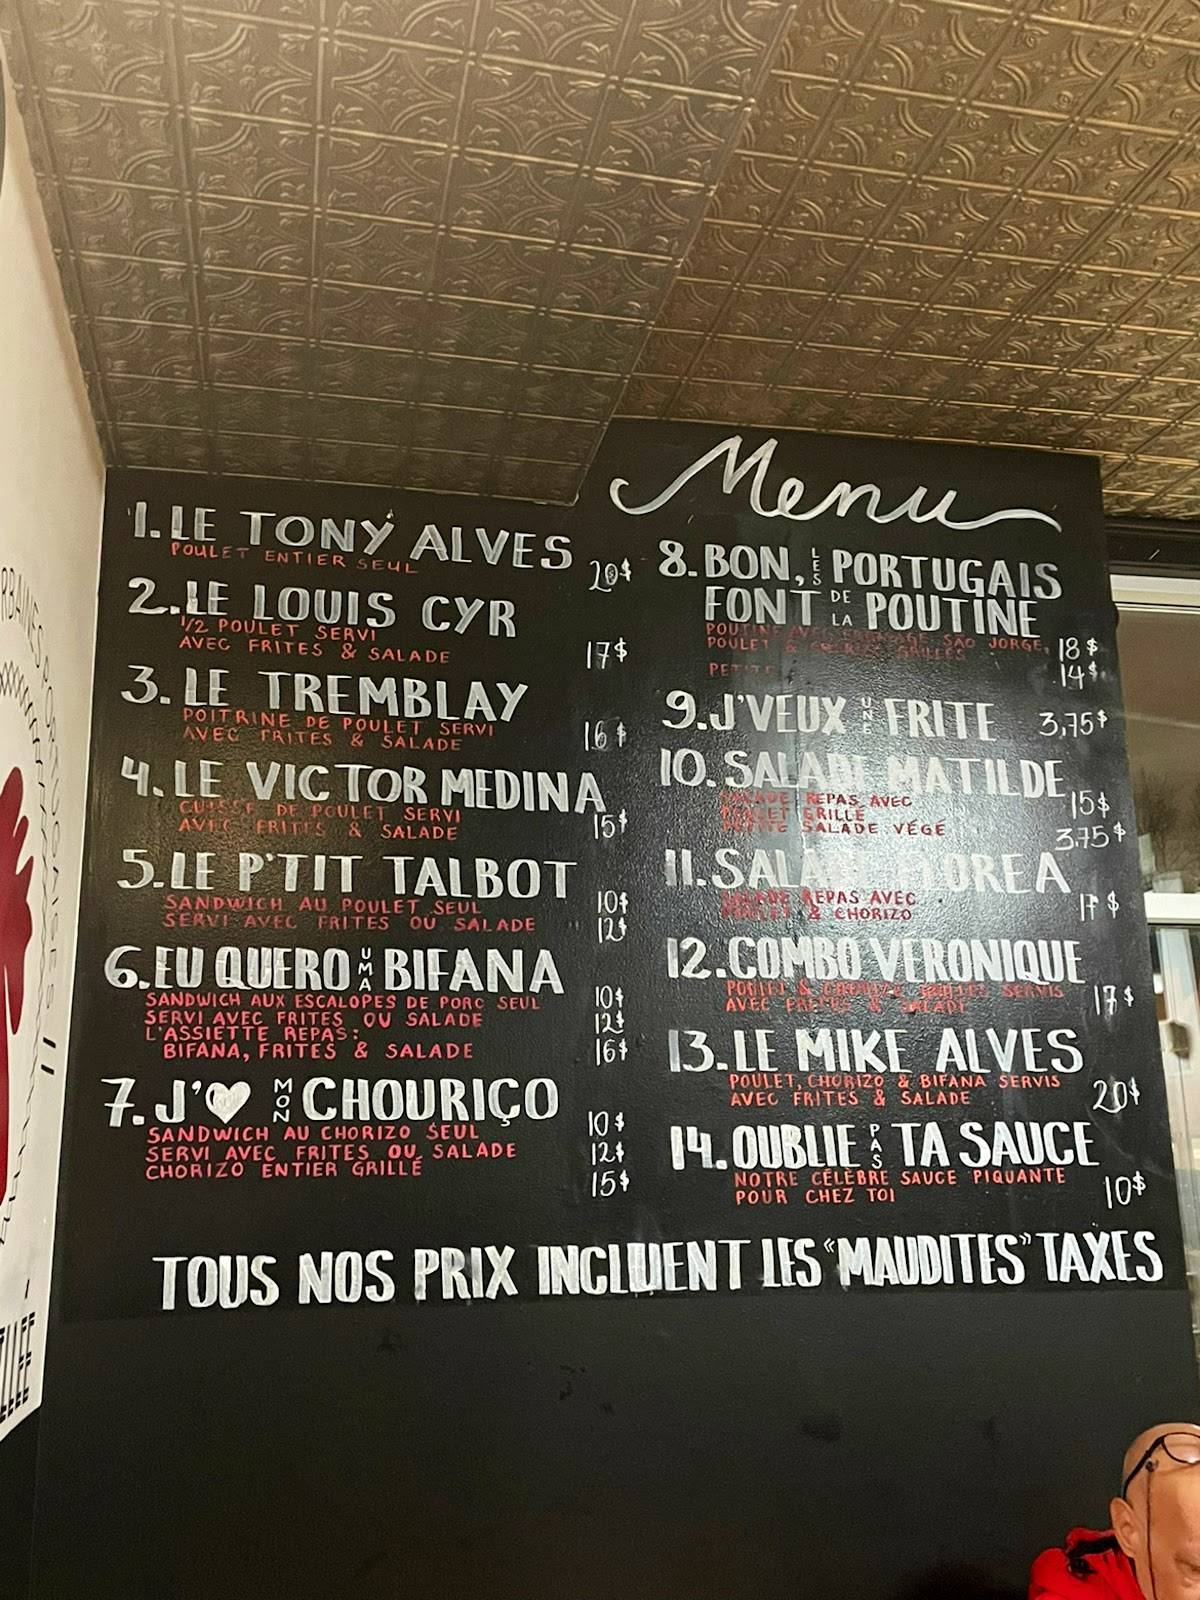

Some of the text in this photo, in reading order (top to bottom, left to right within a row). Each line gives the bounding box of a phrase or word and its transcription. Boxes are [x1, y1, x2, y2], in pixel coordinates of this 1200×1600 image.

[609, 435, 1062, 533] Menu
[240, 510, 395, 555] TONY
[409, 524, 574, 570] ALVES
[171, 541, 418, 574] POULET ENTIER SEUL
[833, 550, 1062, 600] PORTUGAIS
[704, 586, 822, 627] FONT
[831, 589, 850, 603] DE
[253, 584, 396, 628] LOUIS
[422, 594, 516, 638] CYR
[832, 612, 853, 627] LA
[866, 592, 1040, 638] POUTINE
[180, 615, 377, 641] 1/2 POULET SERVI
[179, 635, 450, 664] AVEC FRITES SALADE
[707, 637, 769, 650] POULET
[258, 671, 529, 723] TREMBLAY
[183, 707, 495, 737] POITRINE DE POULET SERVI
[885, 699, 998, 741] FRITE
[259, 728, 463, 752] FRITES SALADE
[245, 761, 428, 805] VICTOR
[440, 768, 608, 813] MEDINA
[889, 756, 1066, 798] MATILDE
[806, 793, 912, 807] REPAS AVEC
[276, 803, 462, 824] DE POULET SERVI
[803, 806, 865, 821] GRILLÉ
[381, 823, 458, 841] SALADE
[802, 818, 946, 836] SALADE VÉGÉ
[239, 852, 363, 893] P'TIT
[382, 855, 577, 899] TALBOT
[164, 895, 480, 916] SANDWICH AU POULET SEUL
[802, 887, 859, 905] REPAS
[871, 891, 916, 905] AVEC
[317, 915, 535, 934] FRITES OU SALADE
[835, 908, 912, 920] CHORIZO
[214, 945, 350, 992] QUERO
[357, 947, 373, 992] UMA
[384, 947, 565, 994] BIFANA
[872, 938, 1085, 986] VERONIQUE
[145, 992, 540, 1010] SANDWICH AUX ESCALOPES DE PORC SEUL
[144, 1009, 483, 1029] SERVI AVEC FRITES OU SALADE
[145, 1025, 269, 1043] L'ASSIETTE
[162, 1042, 474, 1062] BIFANA, FRITES SALADE
[796, 1028, 912, 1074] MIKE
[935, 1027, 1084, 1073] ALVES
[729, 1074, 1060, 1091] POULET, CHORIZO BIFANA SERVIS
[273, 1076, 559, 1127] MON CHOURIÇO
[730, 1090, 970, 1107] AVEC FRITES SALADE
[147, 1122, 480, 1143] SANDWICH AU CHORIZO SEUL
[145, 1142, 517, 1163] SERVI AVEC FRITES OU SALADE
[870, 1123, 882, 1170] PAS
[893, 1123, 949, 1168] TA
[958, 1121, 1100, 1168] SAUCE
[145, 1157, 424, 1181] CHORIZO ENTIER GRILLÉ
[734, 1167, 1065, 1187] NOTRE CÉLÈBRE SAUCE PIQUANTE
[735, 1187, 895, 1205] POUR CHEZ TOI
[152, 1254, 280, 1310] TOUS
[299, 1249, 395, 1304] NOS
[414, 1245, 518, 1300] PRIX
[537, 1239, 751, 1297] INCLUENT
[761, 1236, 822, 1287] LES
[1036, 1229, 1164, 1284] TAXES
